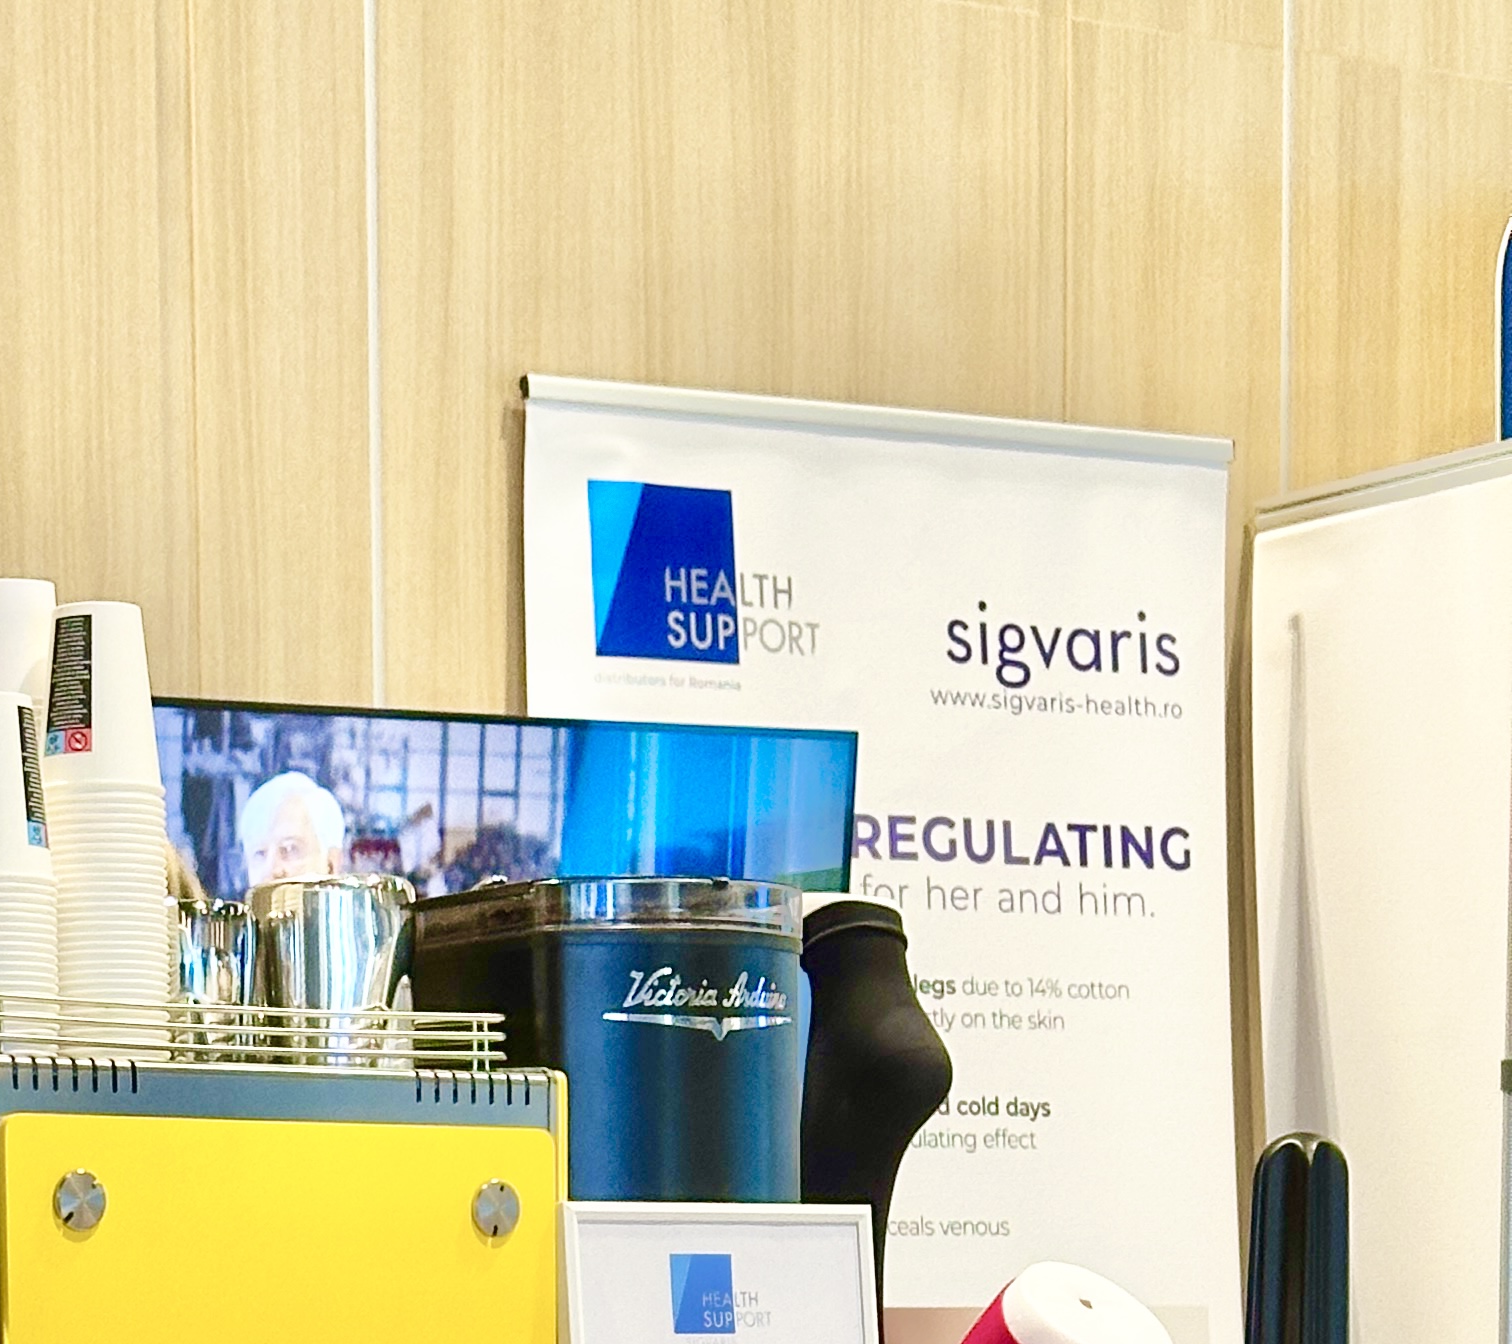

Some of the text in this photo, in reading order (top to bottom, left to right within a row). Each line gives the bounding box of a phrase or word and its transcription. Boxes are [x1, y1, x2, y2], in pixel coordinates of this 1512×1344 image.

[663, 565, 793, 610] HEALTH
[667, 610, 820, 656] SUPPORT
[946, 600, 1181, 688] sigvaris
[930, 688, 1183, 720] www.sigvaris-health.ro
[852, 813, 1192, 871] REGULATING
[860, 873, 1156, 917] for her and him.
[622, 966, 788, 1011] Victoria Arduino
[914, 973, 1130, 1000] legs due to 14% cotton
[928, 1007, 1065, 1033] tly on the skin
[957, 1095, 999, 1117] cold
[1006, 1096, 1051, 1123] days
[983, 1128, 1037, 1150] effect
[939, 1219, 1011, 1237] venous
[702, 1291, 759, 1308] HEALTH
[703, 1310, 771, 1328] SUPPORT
